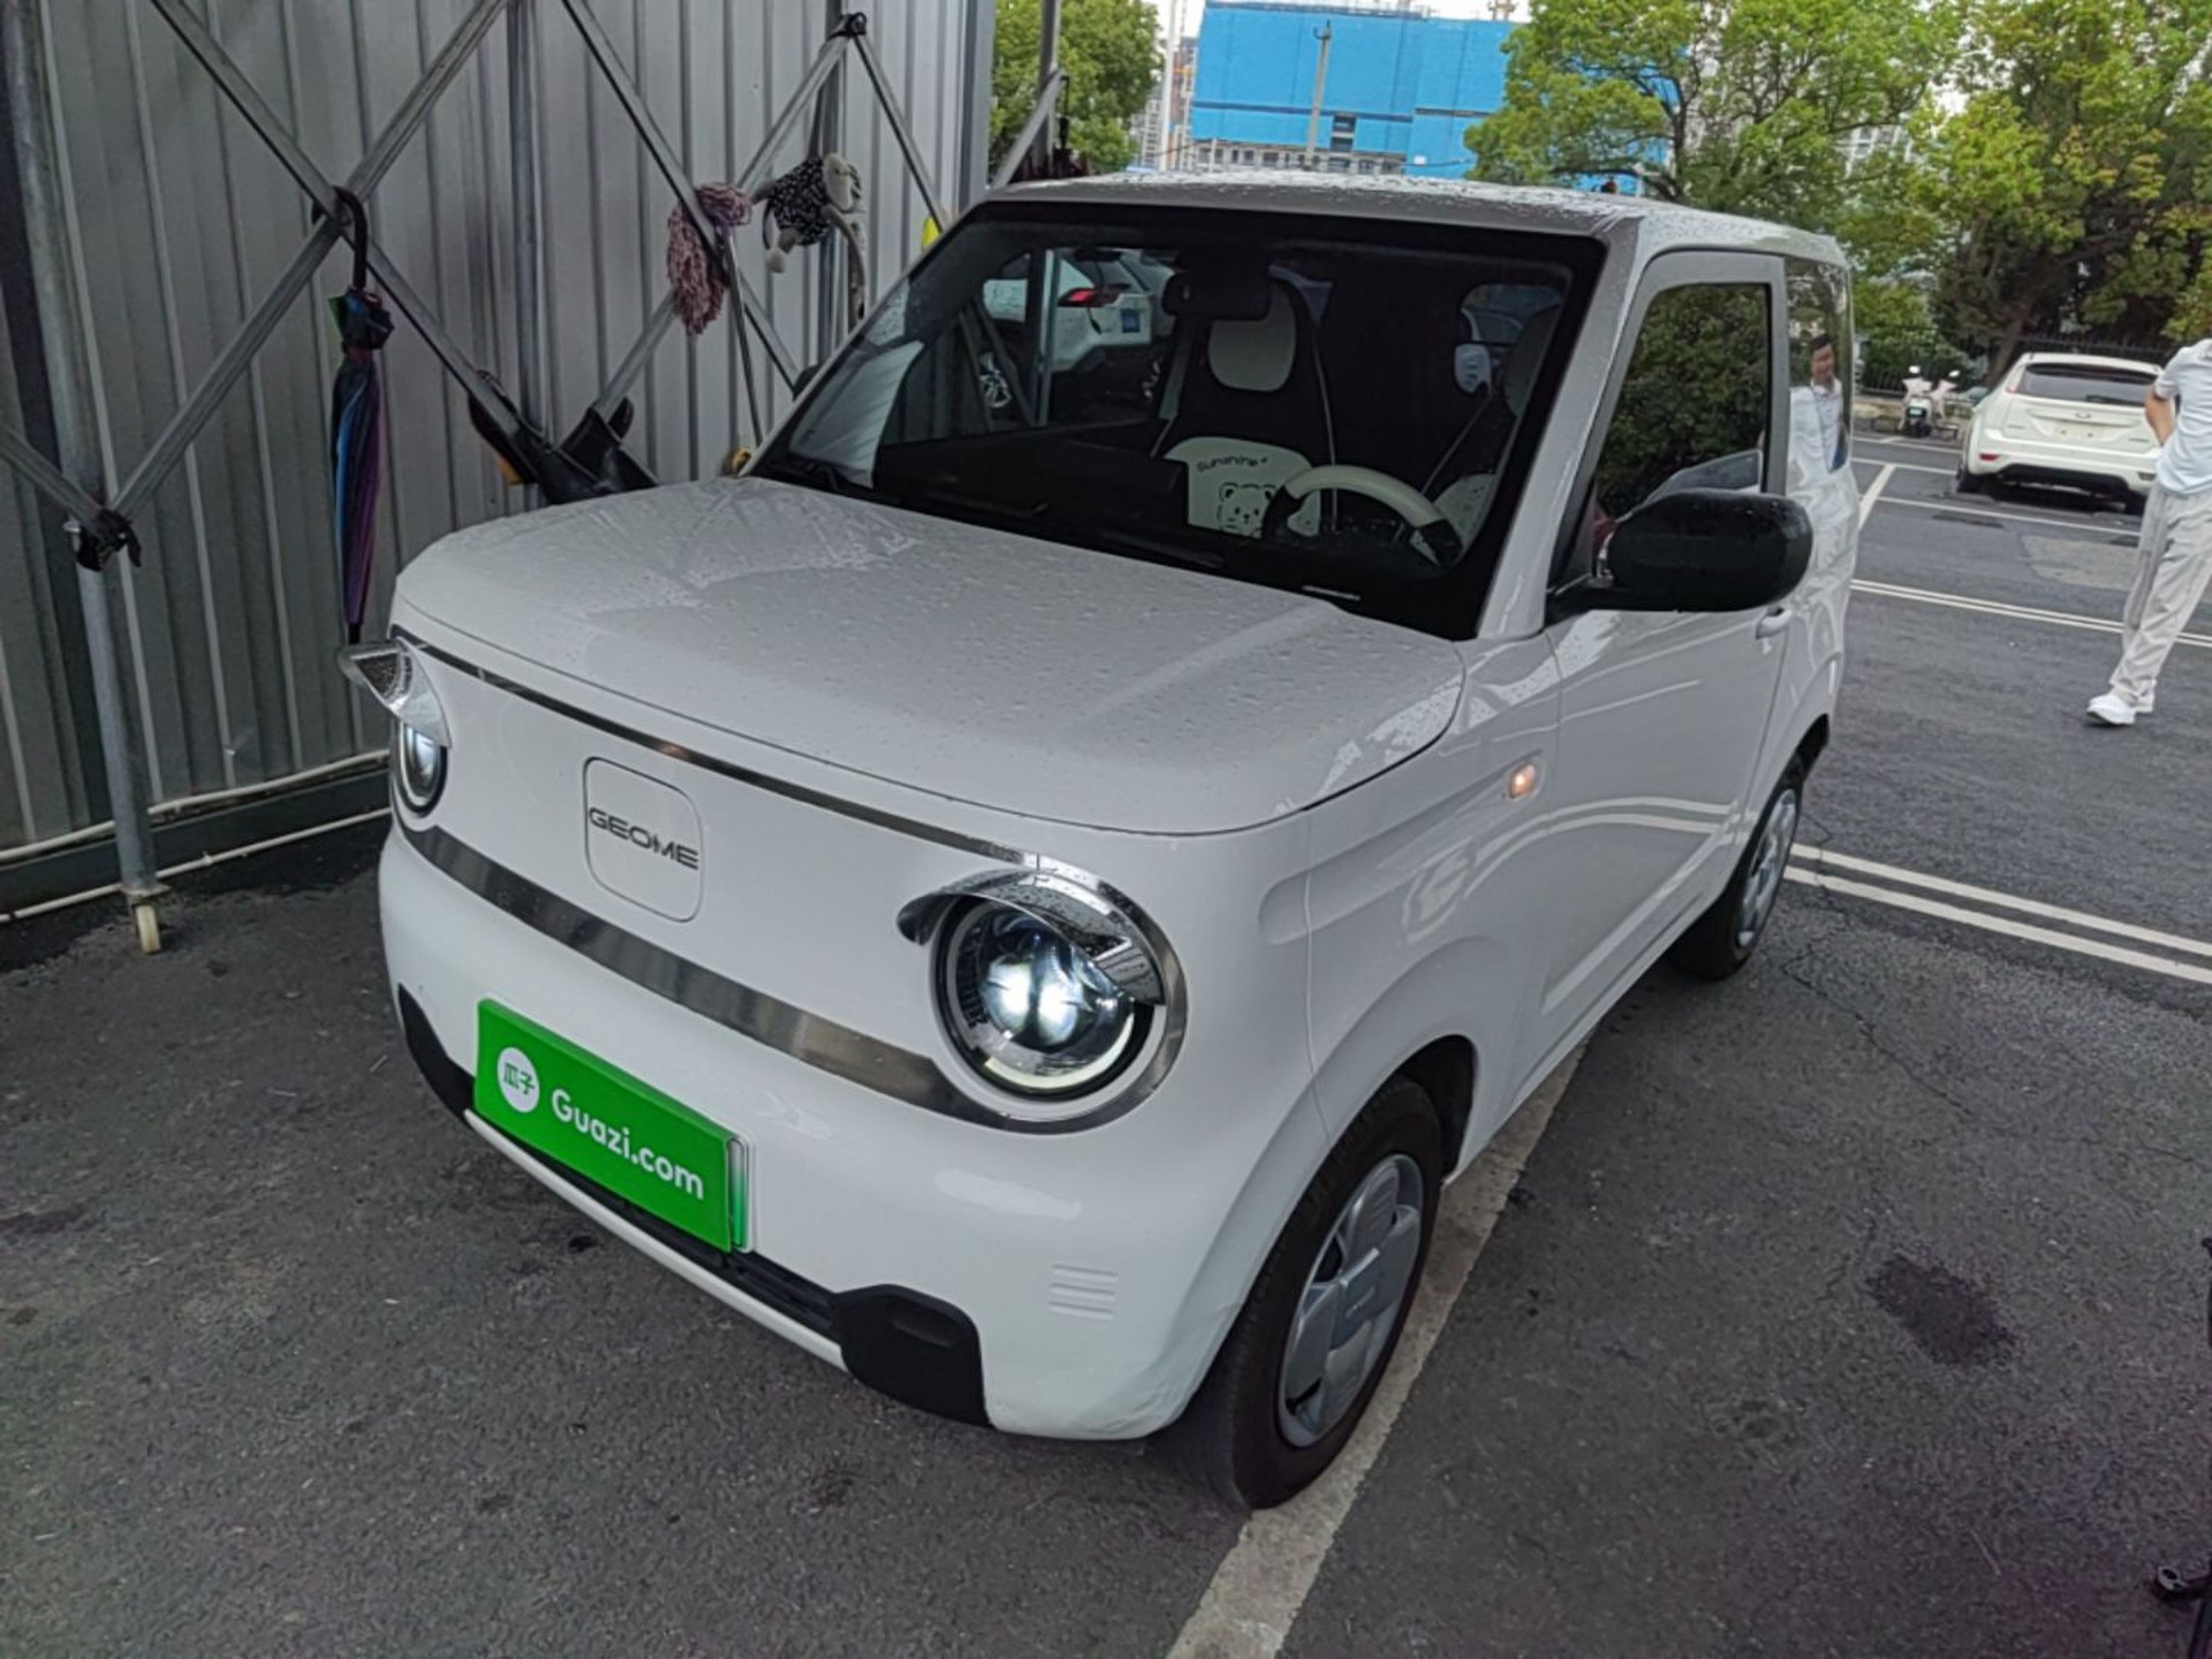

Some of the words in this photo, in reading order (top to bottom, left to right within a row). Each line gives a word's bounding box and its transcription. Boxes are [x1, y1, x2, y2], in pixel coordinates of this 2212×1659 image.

[589, 807, 699, 870] GEOME
[503, 1062, 535, 1095] 瓜子
[551, 1088, 704, 1200] Guazi.com
